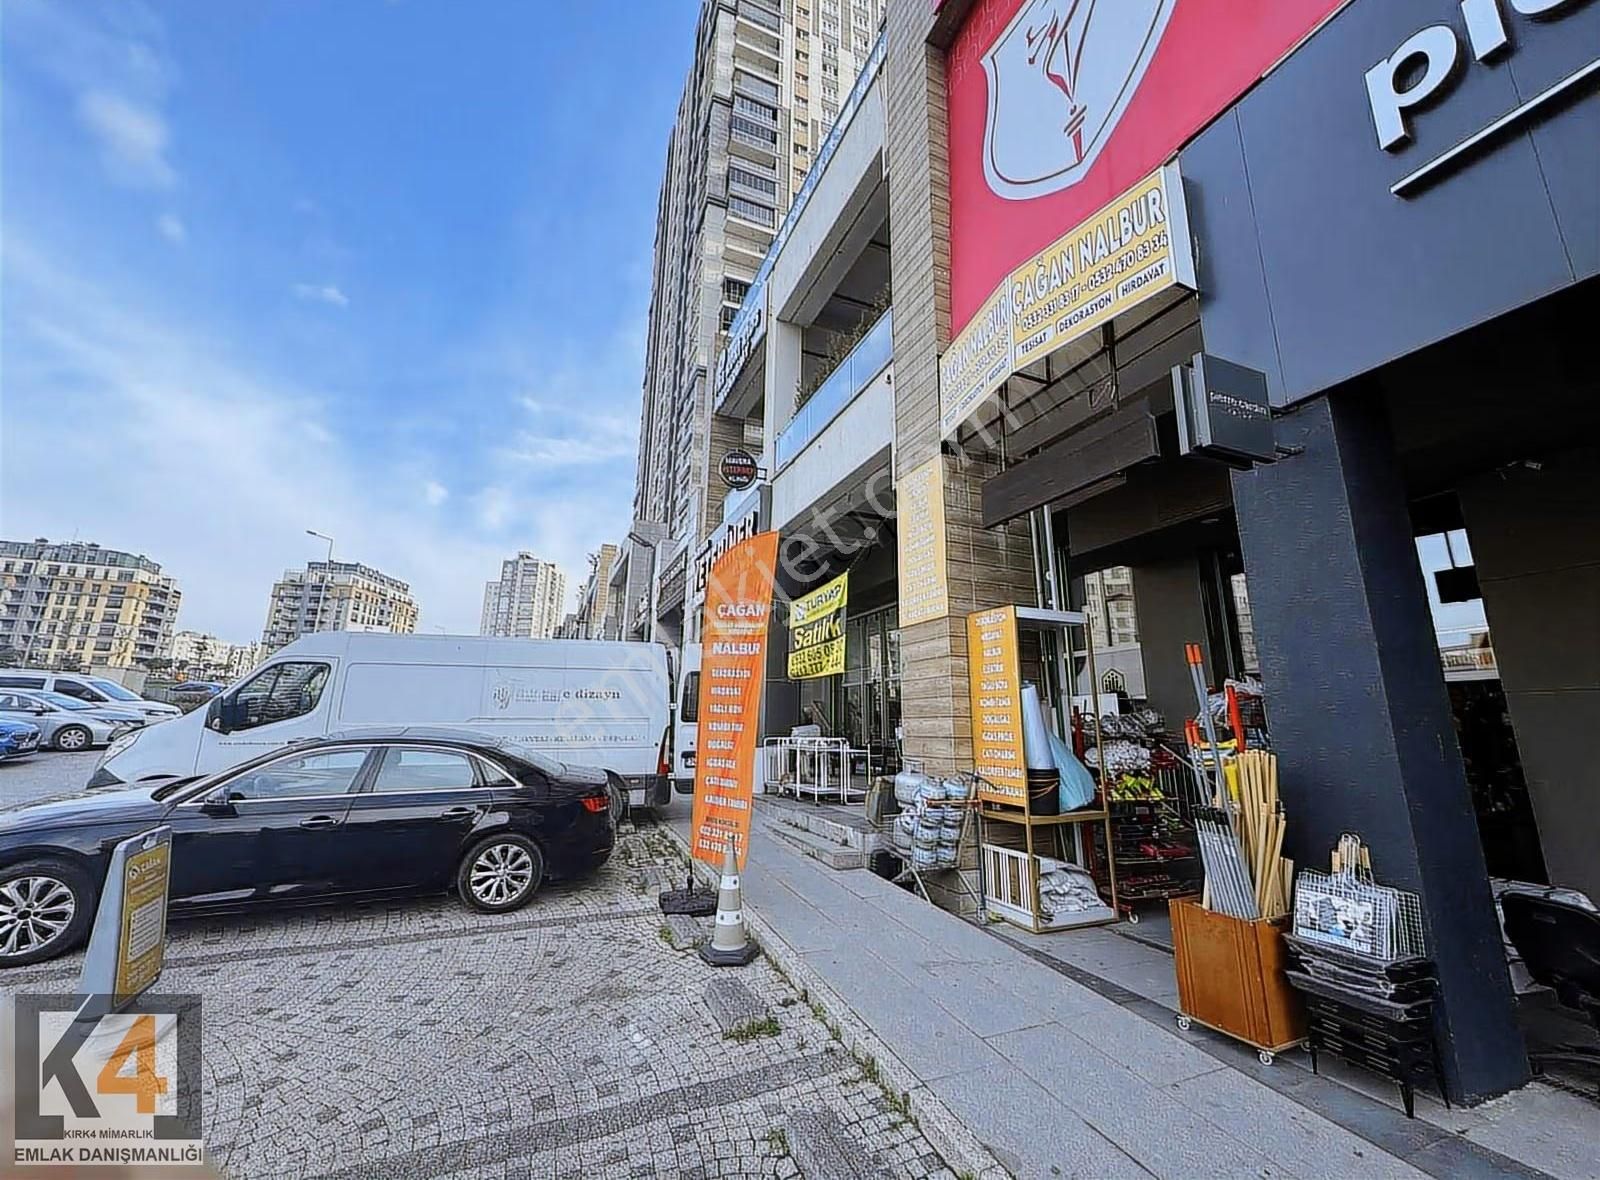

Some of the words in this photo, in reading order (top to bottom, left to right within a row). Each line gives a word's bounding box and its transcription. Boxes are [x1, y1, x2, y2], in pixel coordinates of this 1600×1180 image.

[1011, 253, 1075, 327] ÇAĞAN
[1078, 187, 1166, 273] NALBUR
[1059, 292, 1112, 334] DEKORASYON
[1121, 262, 1165, 297] HIRDAVAT
[717, 601, 765, 619] ÇAĞAN
